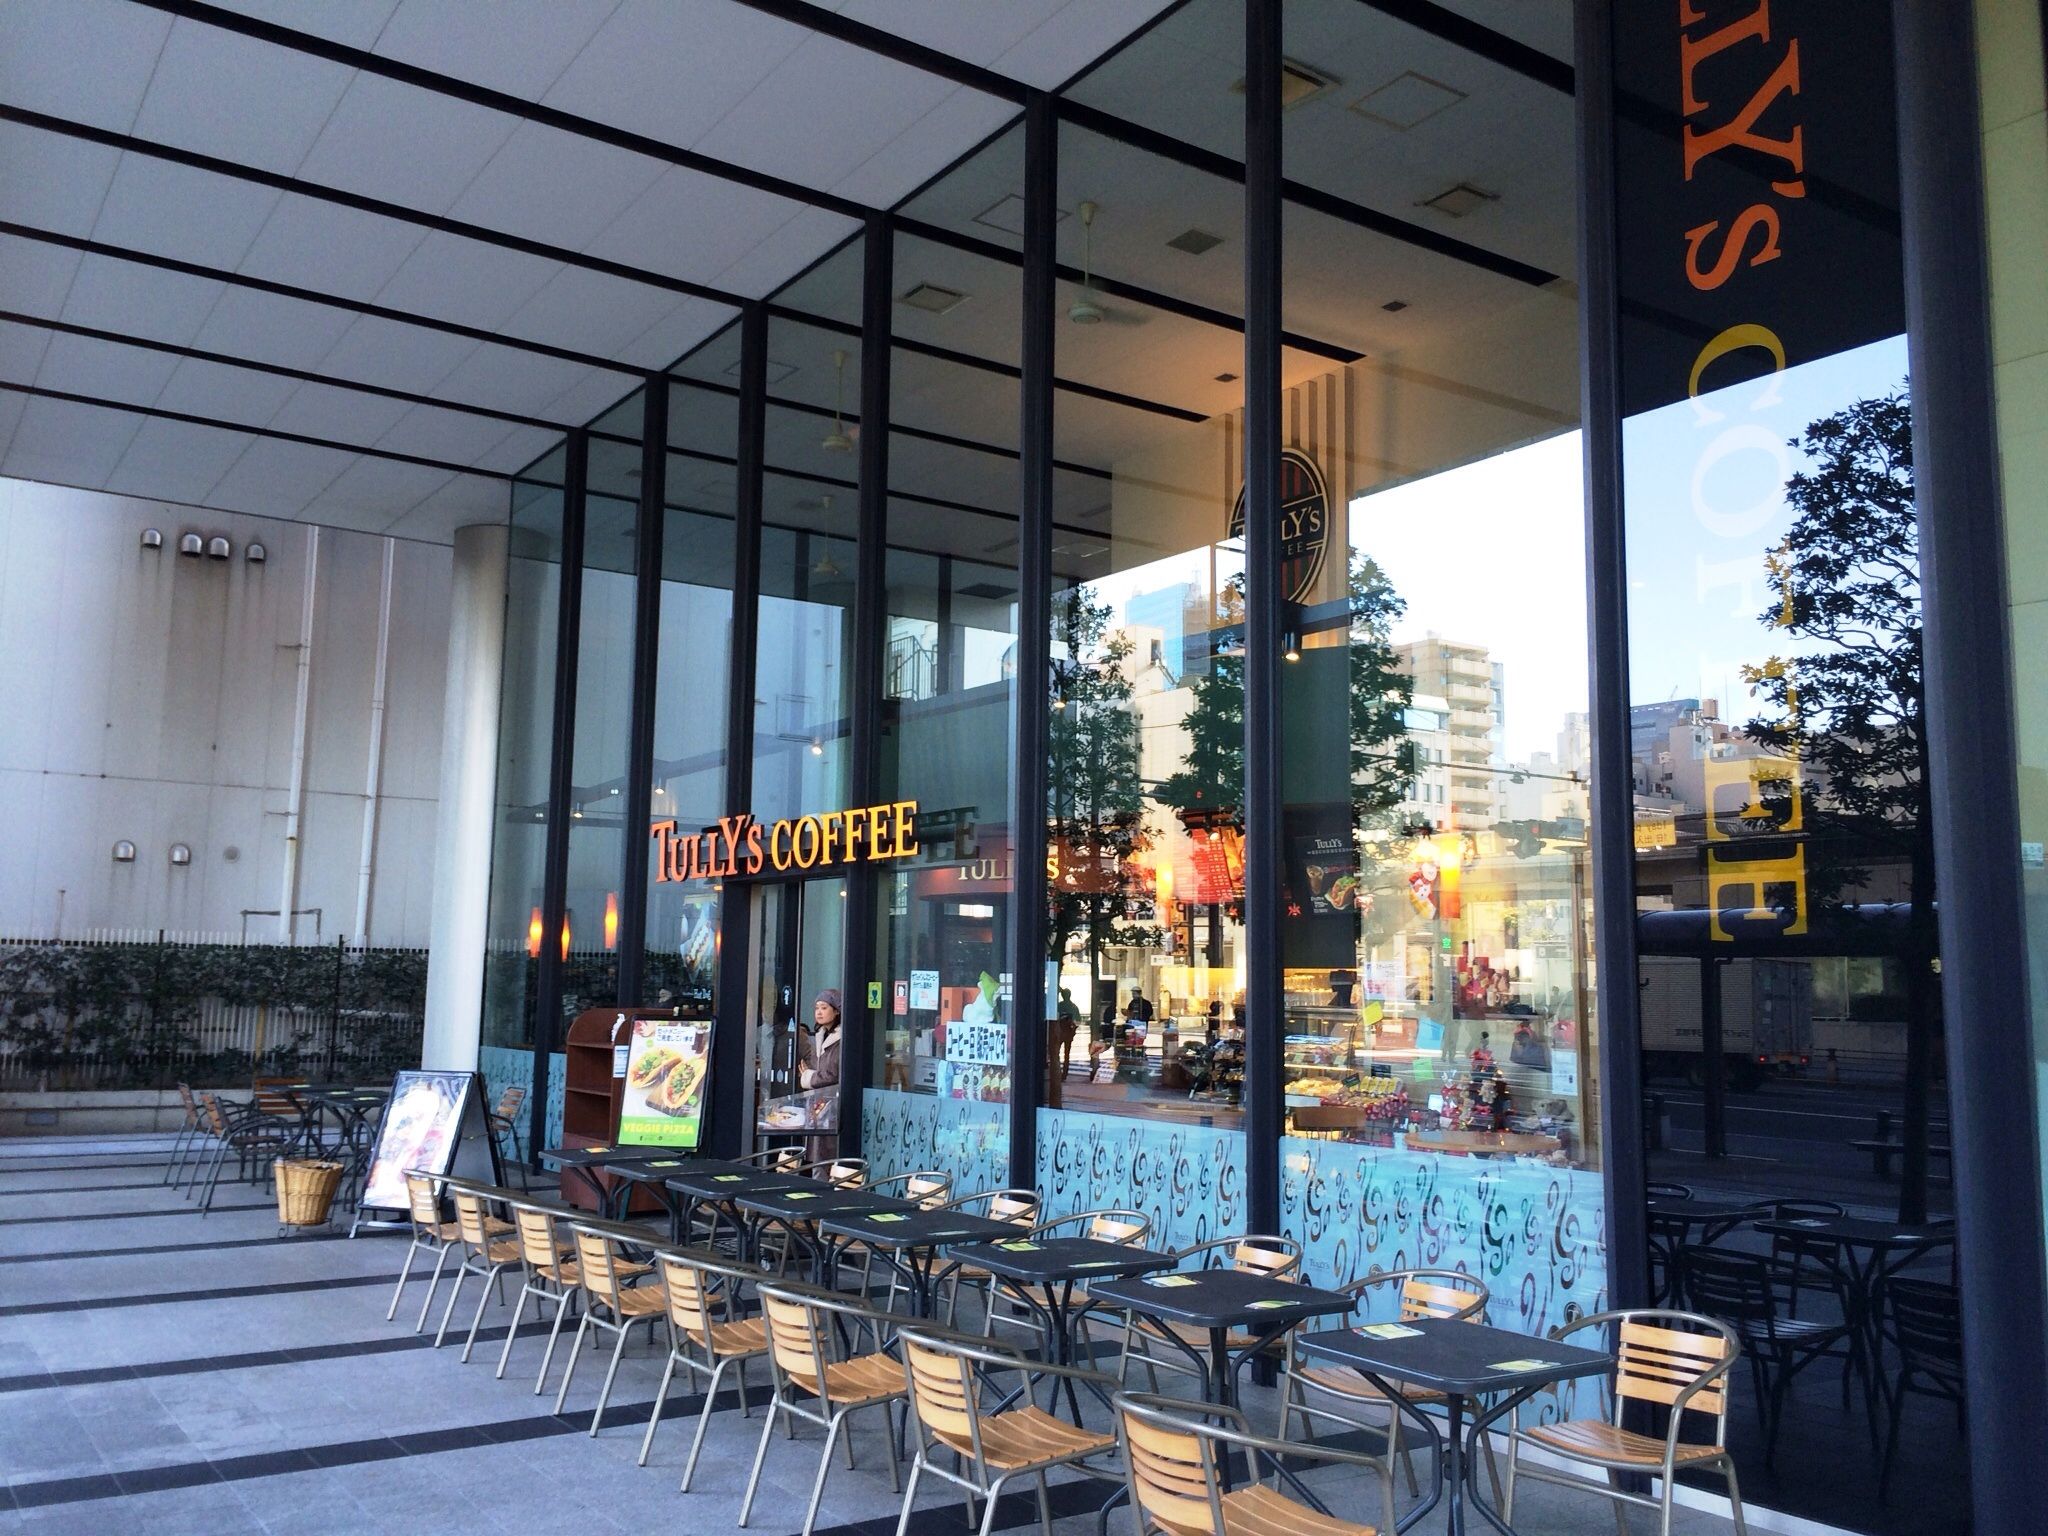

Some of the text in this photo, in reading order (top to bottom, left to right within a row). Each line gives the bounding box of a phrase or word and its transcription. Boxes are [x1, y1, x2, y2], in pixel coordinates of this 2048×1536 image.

[771, 801, 920, 871] COFFEE
[622, 1122, 695, 1134] VEGGIE PIZZA
